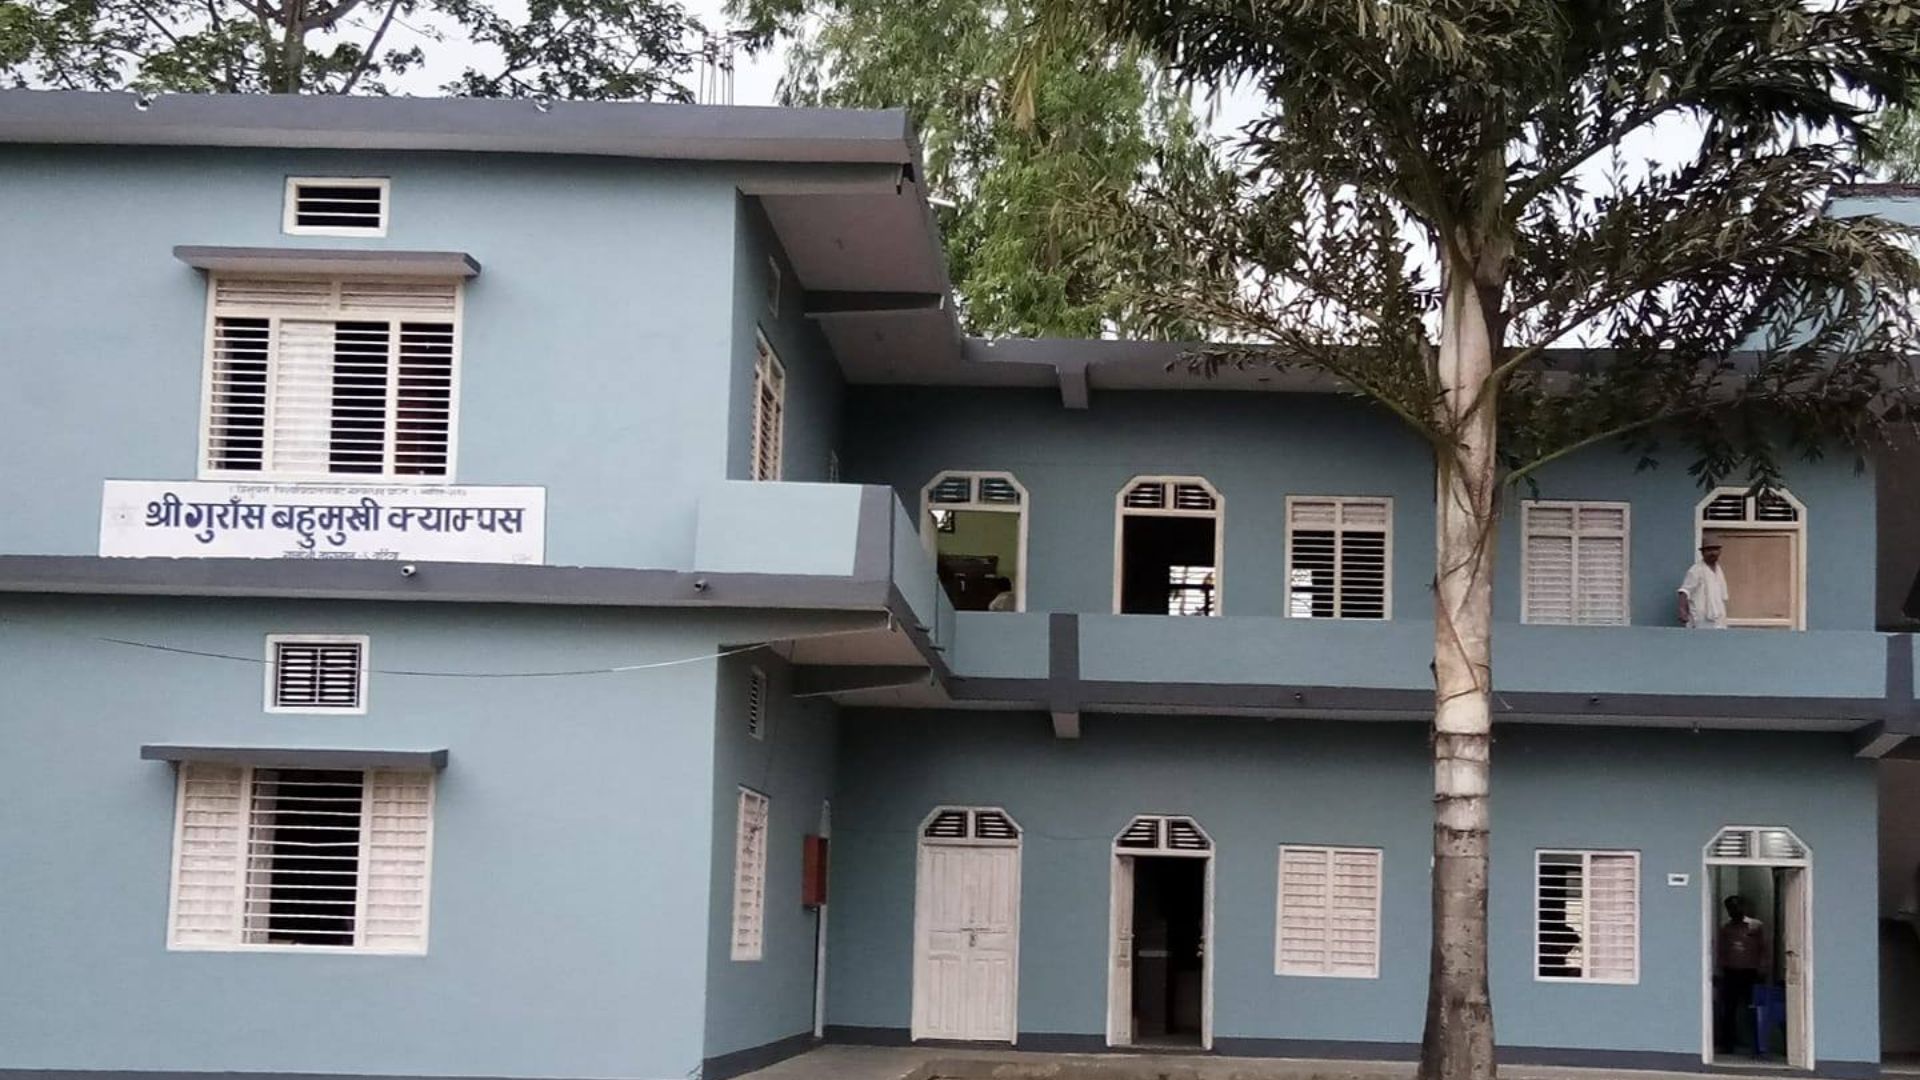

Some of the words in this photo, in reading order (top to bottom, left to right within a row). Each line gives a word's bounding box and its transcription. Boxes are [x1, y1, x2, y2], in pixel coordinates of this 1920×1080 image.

[145, 492, 182, 529] श्री
[185, 497, 266, 543] गुराँस
[271, 496, 383, 548] बहुमुखी
[387, 506, 525, 535] क्याम्पस
